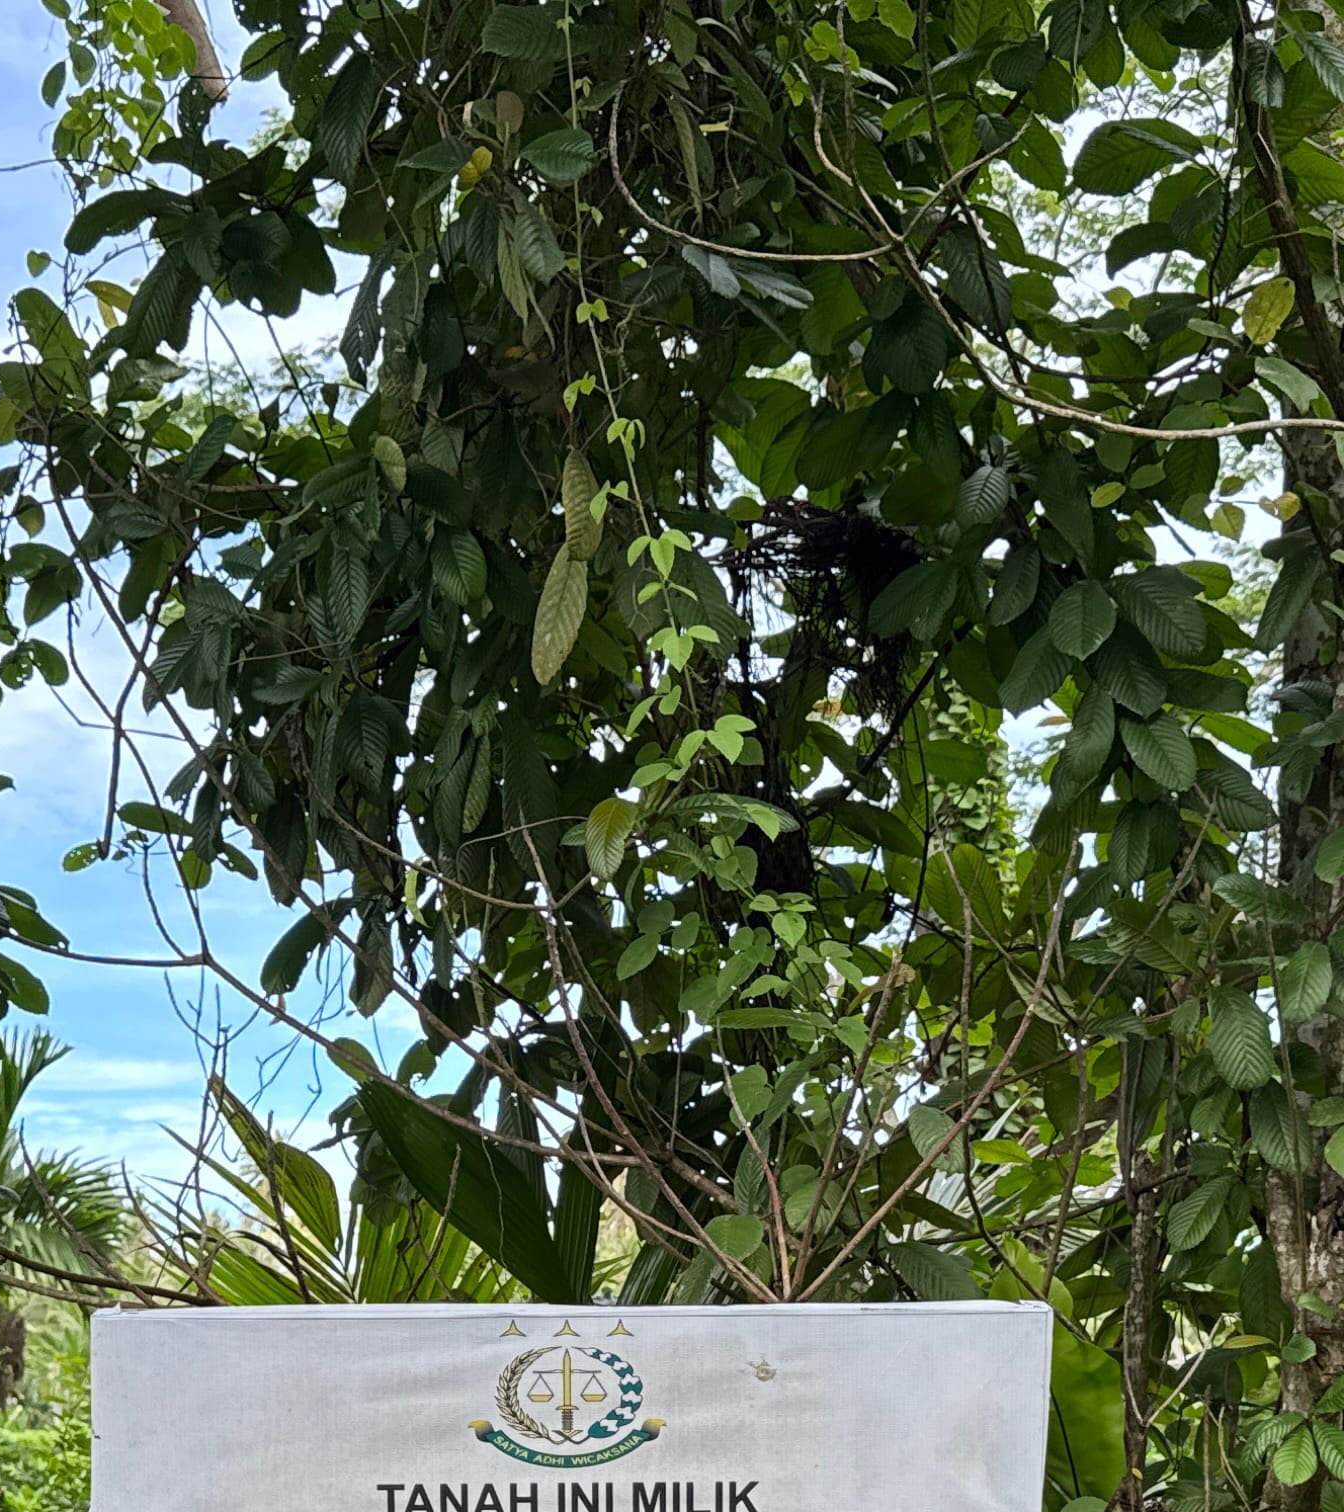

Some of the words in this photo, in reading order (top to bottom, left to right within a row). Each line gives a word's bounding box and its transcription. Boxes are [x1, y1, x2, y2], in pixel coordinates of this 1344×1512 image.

[494, 1435, 529, 1459] SATYA
[532, 1454, 565, 1465] ADHI
[570, 1435, 642, 1465] WICAKSANA
